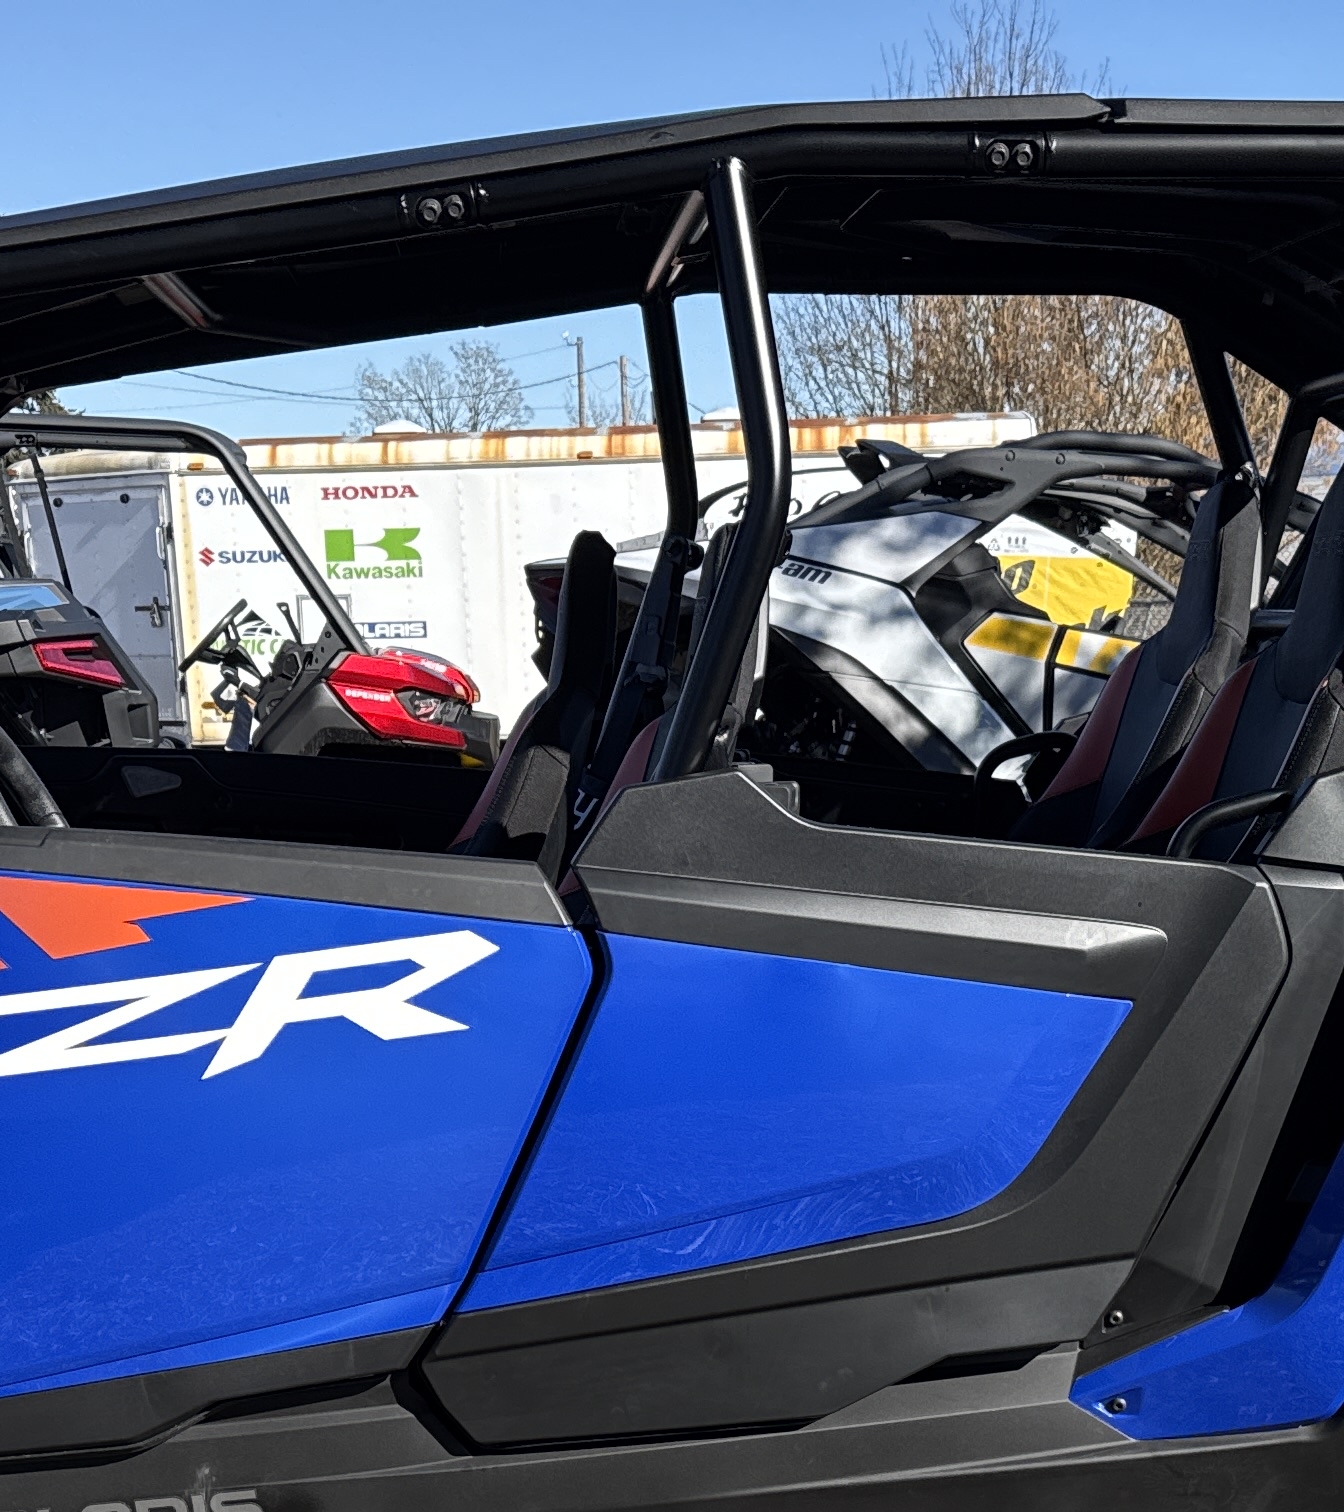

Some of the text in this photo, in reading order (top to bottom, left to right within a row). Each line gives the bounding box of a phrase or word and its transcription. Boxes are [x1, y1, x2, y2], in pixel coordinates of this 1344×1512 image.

[217, 486, 291, 506] YAHA
[321, 485, 419, 501] HONDA
[217, 550, 288, 565] SUZUK
[326, 561, 424, 580] Kawasaki
